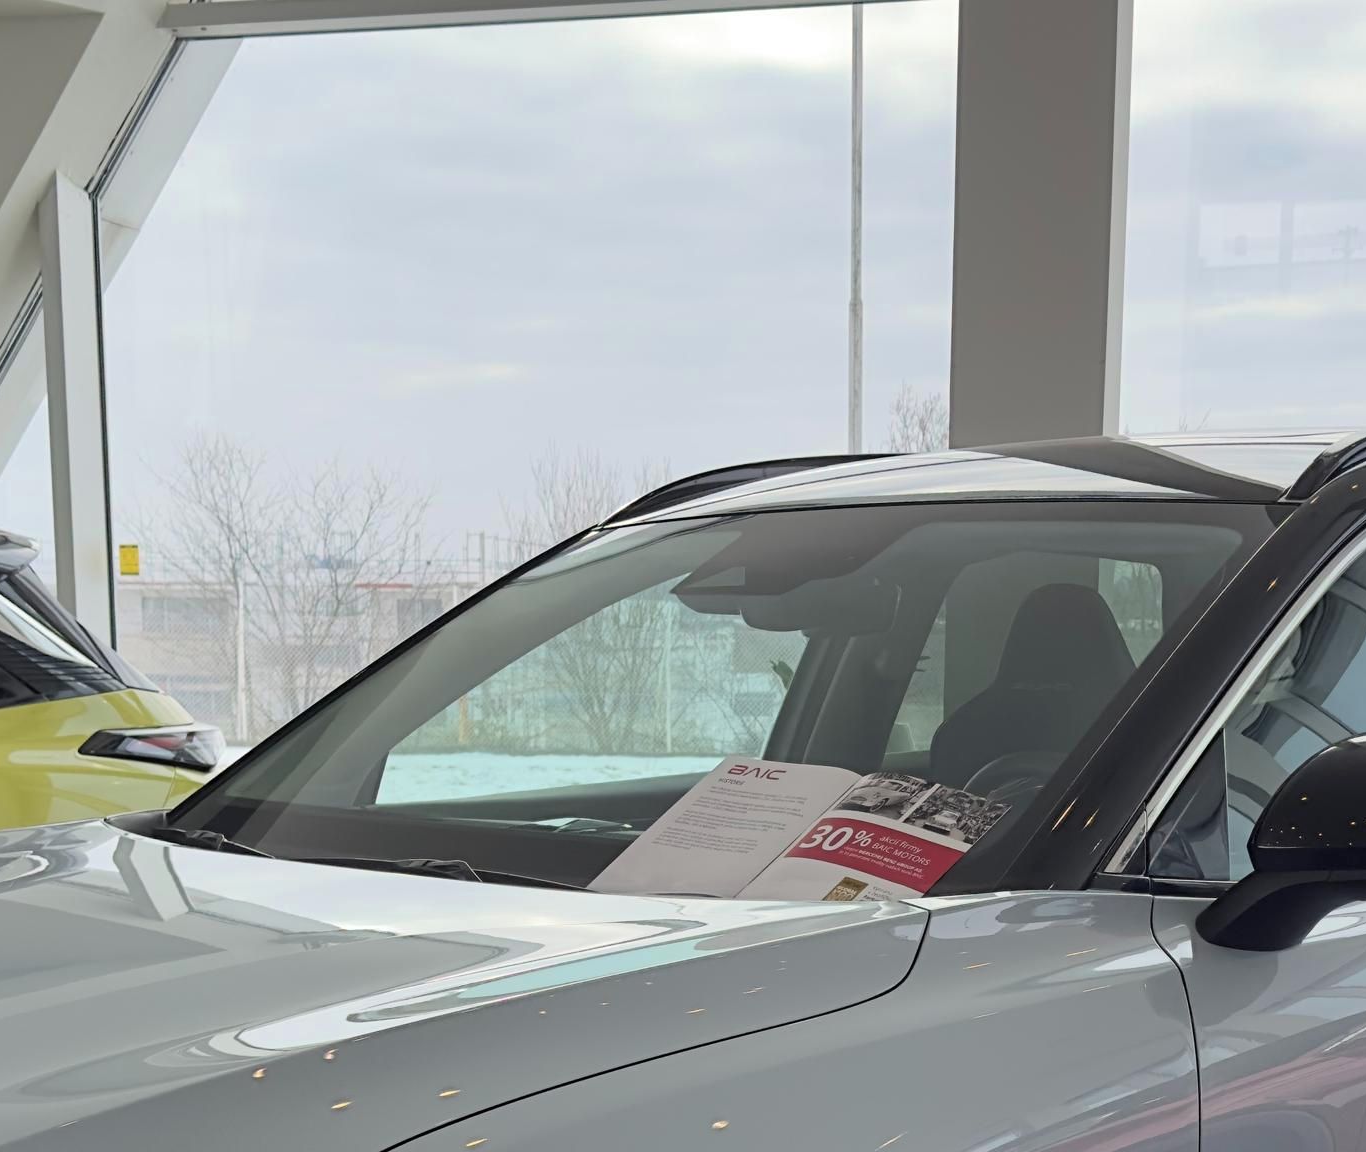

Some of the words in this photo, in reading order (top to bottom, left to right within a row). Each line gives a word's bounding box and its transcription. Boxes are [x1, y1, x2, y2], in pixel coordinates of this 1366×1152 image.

[728, 765, 787, 780] BAIC
[900, 838, 923, 853] firmy
[872, 842, 892, 854] BAIC
[892, 848, 931, 866] MOTORS
